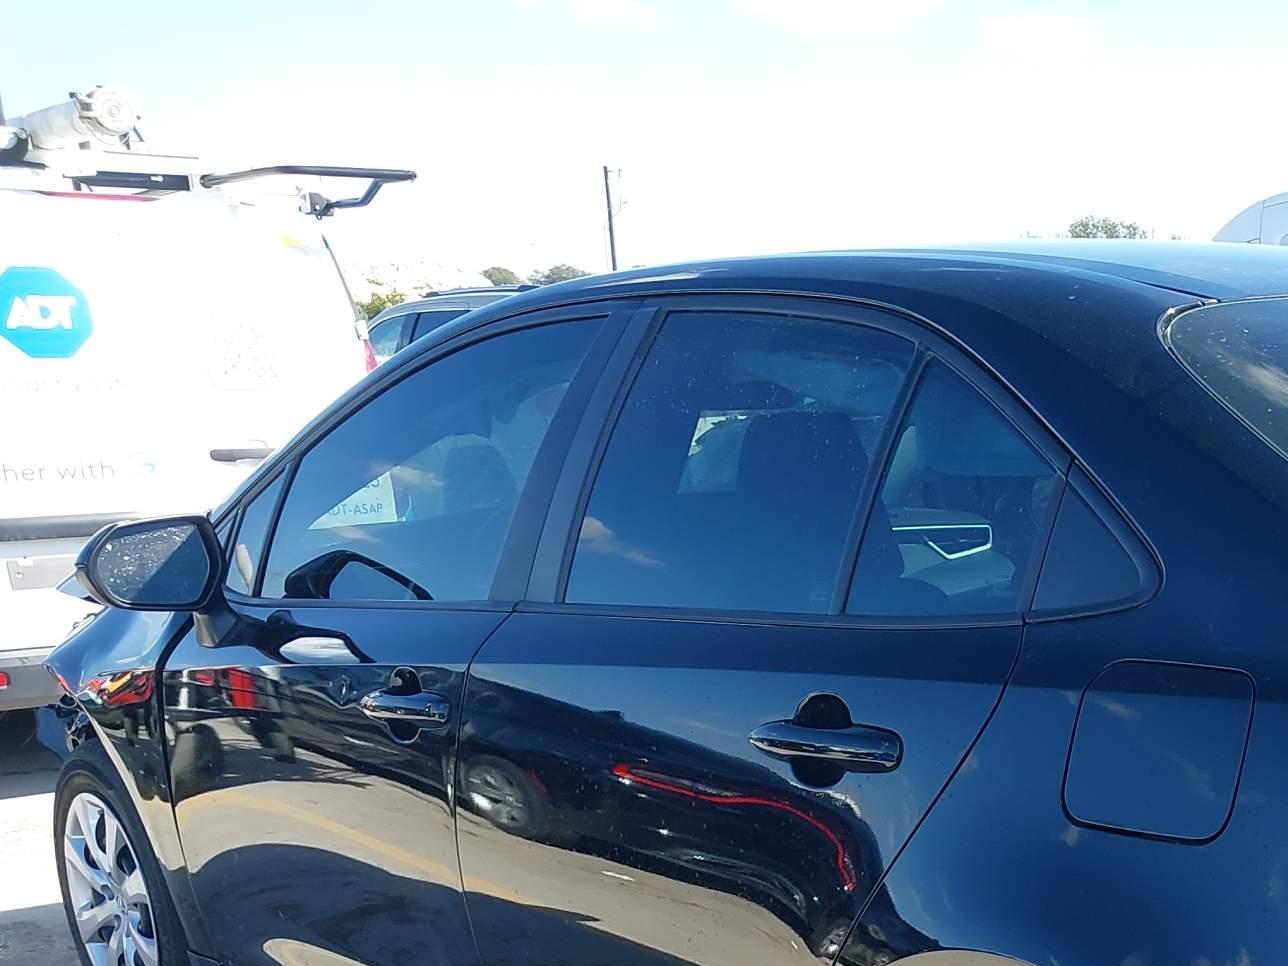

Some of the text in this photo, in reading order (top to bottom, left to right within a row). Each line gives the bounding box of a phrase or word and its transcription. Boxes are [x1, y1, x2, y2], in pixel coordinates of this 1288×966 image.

[6, 294, 77, 330] ADT
[56, 460, 115, 480] with
[327, 503, 384, 516] DT-ASAP
